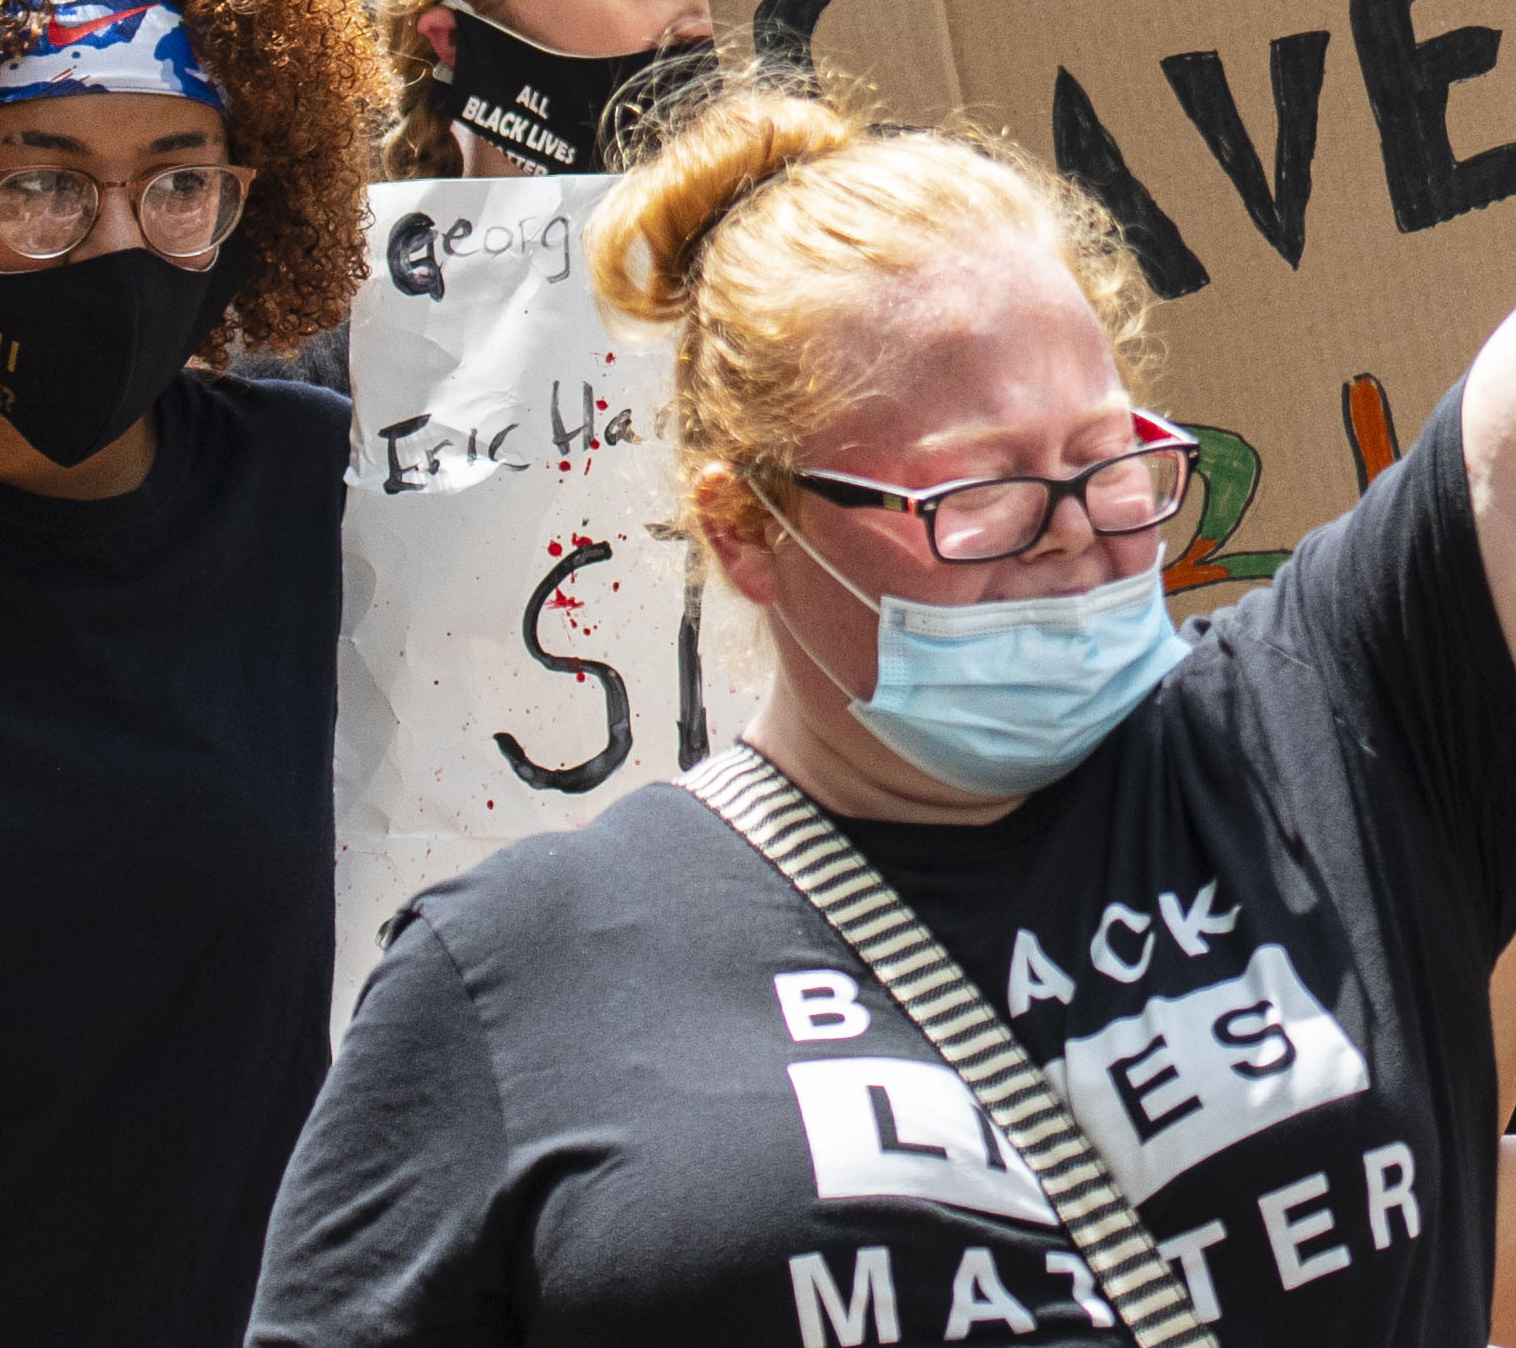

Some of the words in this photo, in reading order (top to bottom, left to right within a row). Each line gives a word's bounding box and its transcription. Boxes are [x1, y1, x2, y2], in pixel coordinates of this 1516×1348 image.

[461, 95, 529, 144] BLACK
[525, 124, 576, 165] LIVES
[515, 84, 549, 121] ALL
[7, 340, 21, 373] I
[377, 413, 532, 495] Eric
[773, 878, 1242, 1043] BACK
[866, 998, 1297, 1178] LIES
